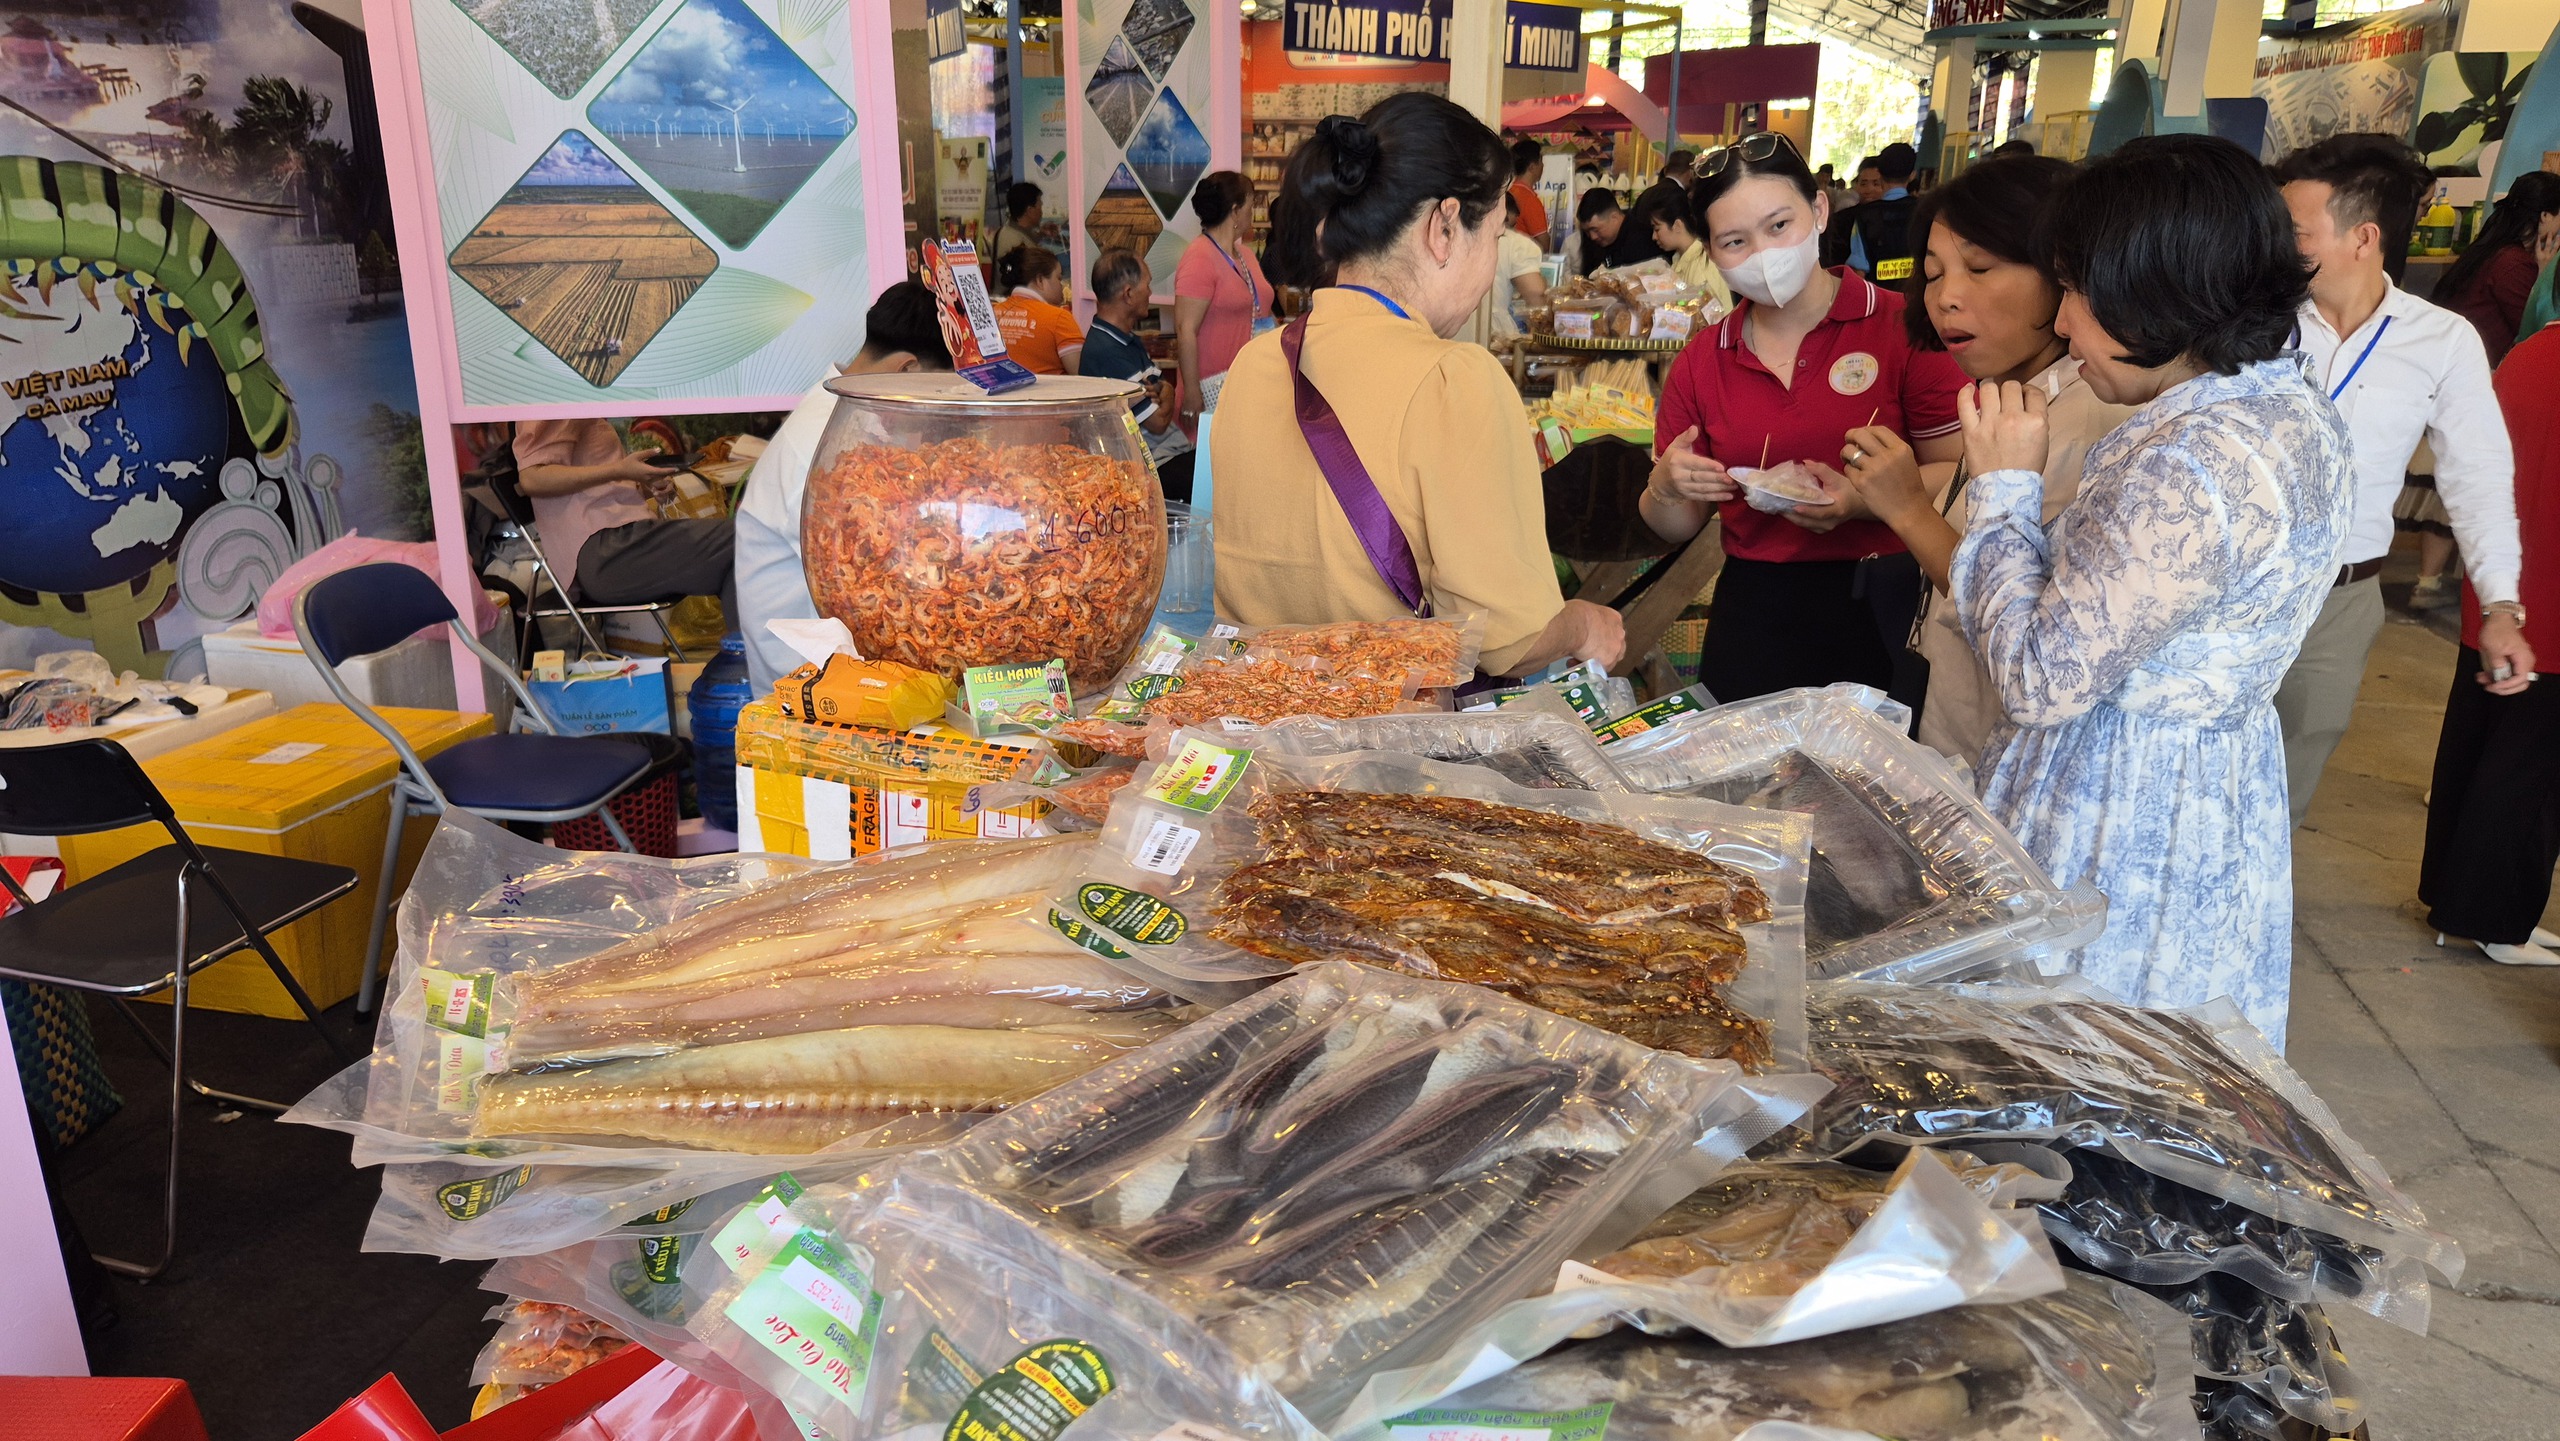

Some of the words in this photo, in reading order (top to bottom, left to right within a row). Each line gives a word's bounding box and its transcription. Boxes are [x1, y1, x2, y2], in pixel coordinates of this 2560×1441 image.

[1294, 0, 1378, 53] THÀNH
[1385, 7, 1433, 58] PHỐ
[1519, 25, 1575, 68] MINH
[1545, 181, 1566, 193] App
[943, 239, 974, 254] Sacombank
[1, 370, 64, 400] VIỆT
[66, 359, 131, 388] NAM
[60, 389, 114, 413] MAU
[1077, 503, 1125, 544] 600
[1007, 666, 1042, 682] HẠNH
[614, 709, 637, 719] PHẨM
[778, 1180, 797, 1199] lạnh
[735, 1243, 750, 1261] óc
[800, 1233, 824, 1261] lạnh
[764, 1313, 801, 1345] Lóc
[824, 1322, 850, 1356] tháng
[796, 1339, 825, 1366] Cá
[823, 1357, 853, 1395] Khô
